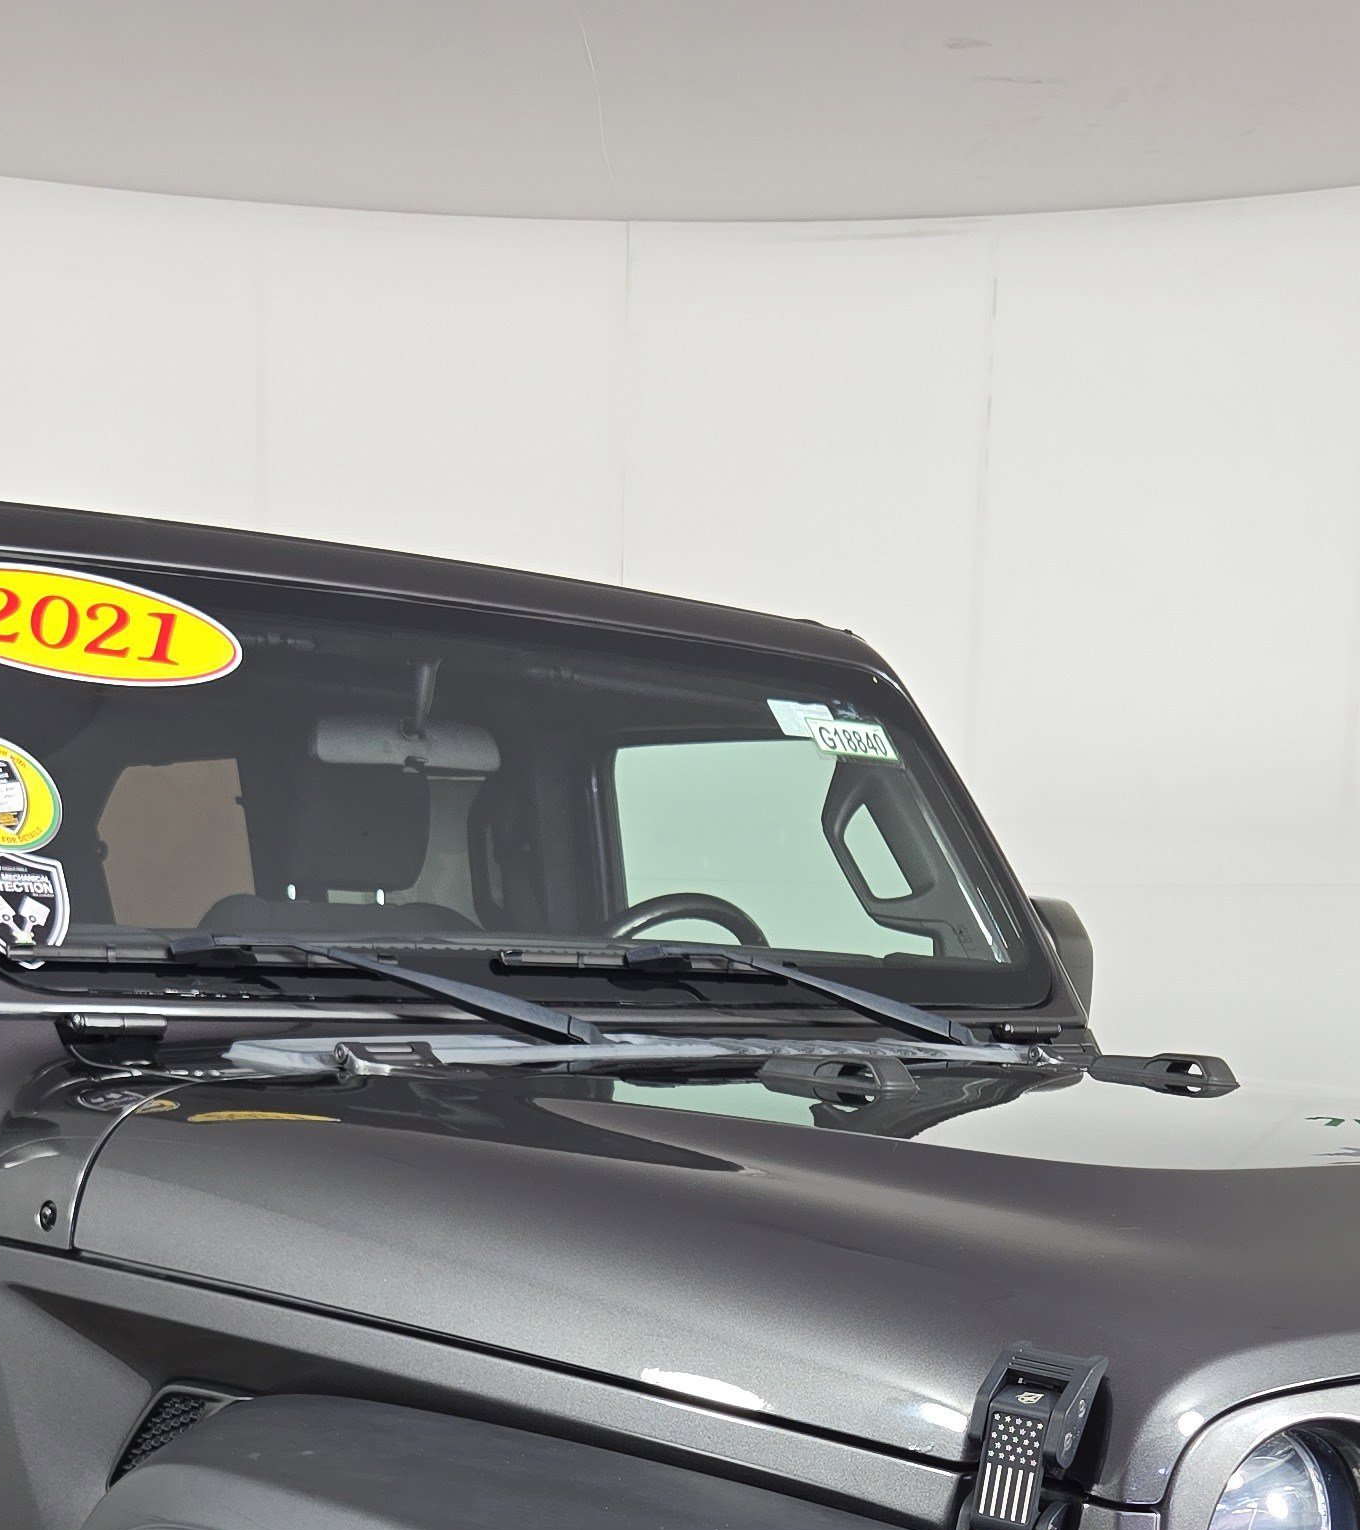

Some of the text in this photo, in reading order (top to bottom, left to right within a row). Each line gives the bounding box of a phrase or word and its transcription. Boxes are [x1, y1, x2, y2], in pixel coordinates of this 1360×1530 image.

[818, 726, 888, 757] G18840
[1, 835, 18, 844] FOR
[0, 872, 50, 883] MECHANICAL
